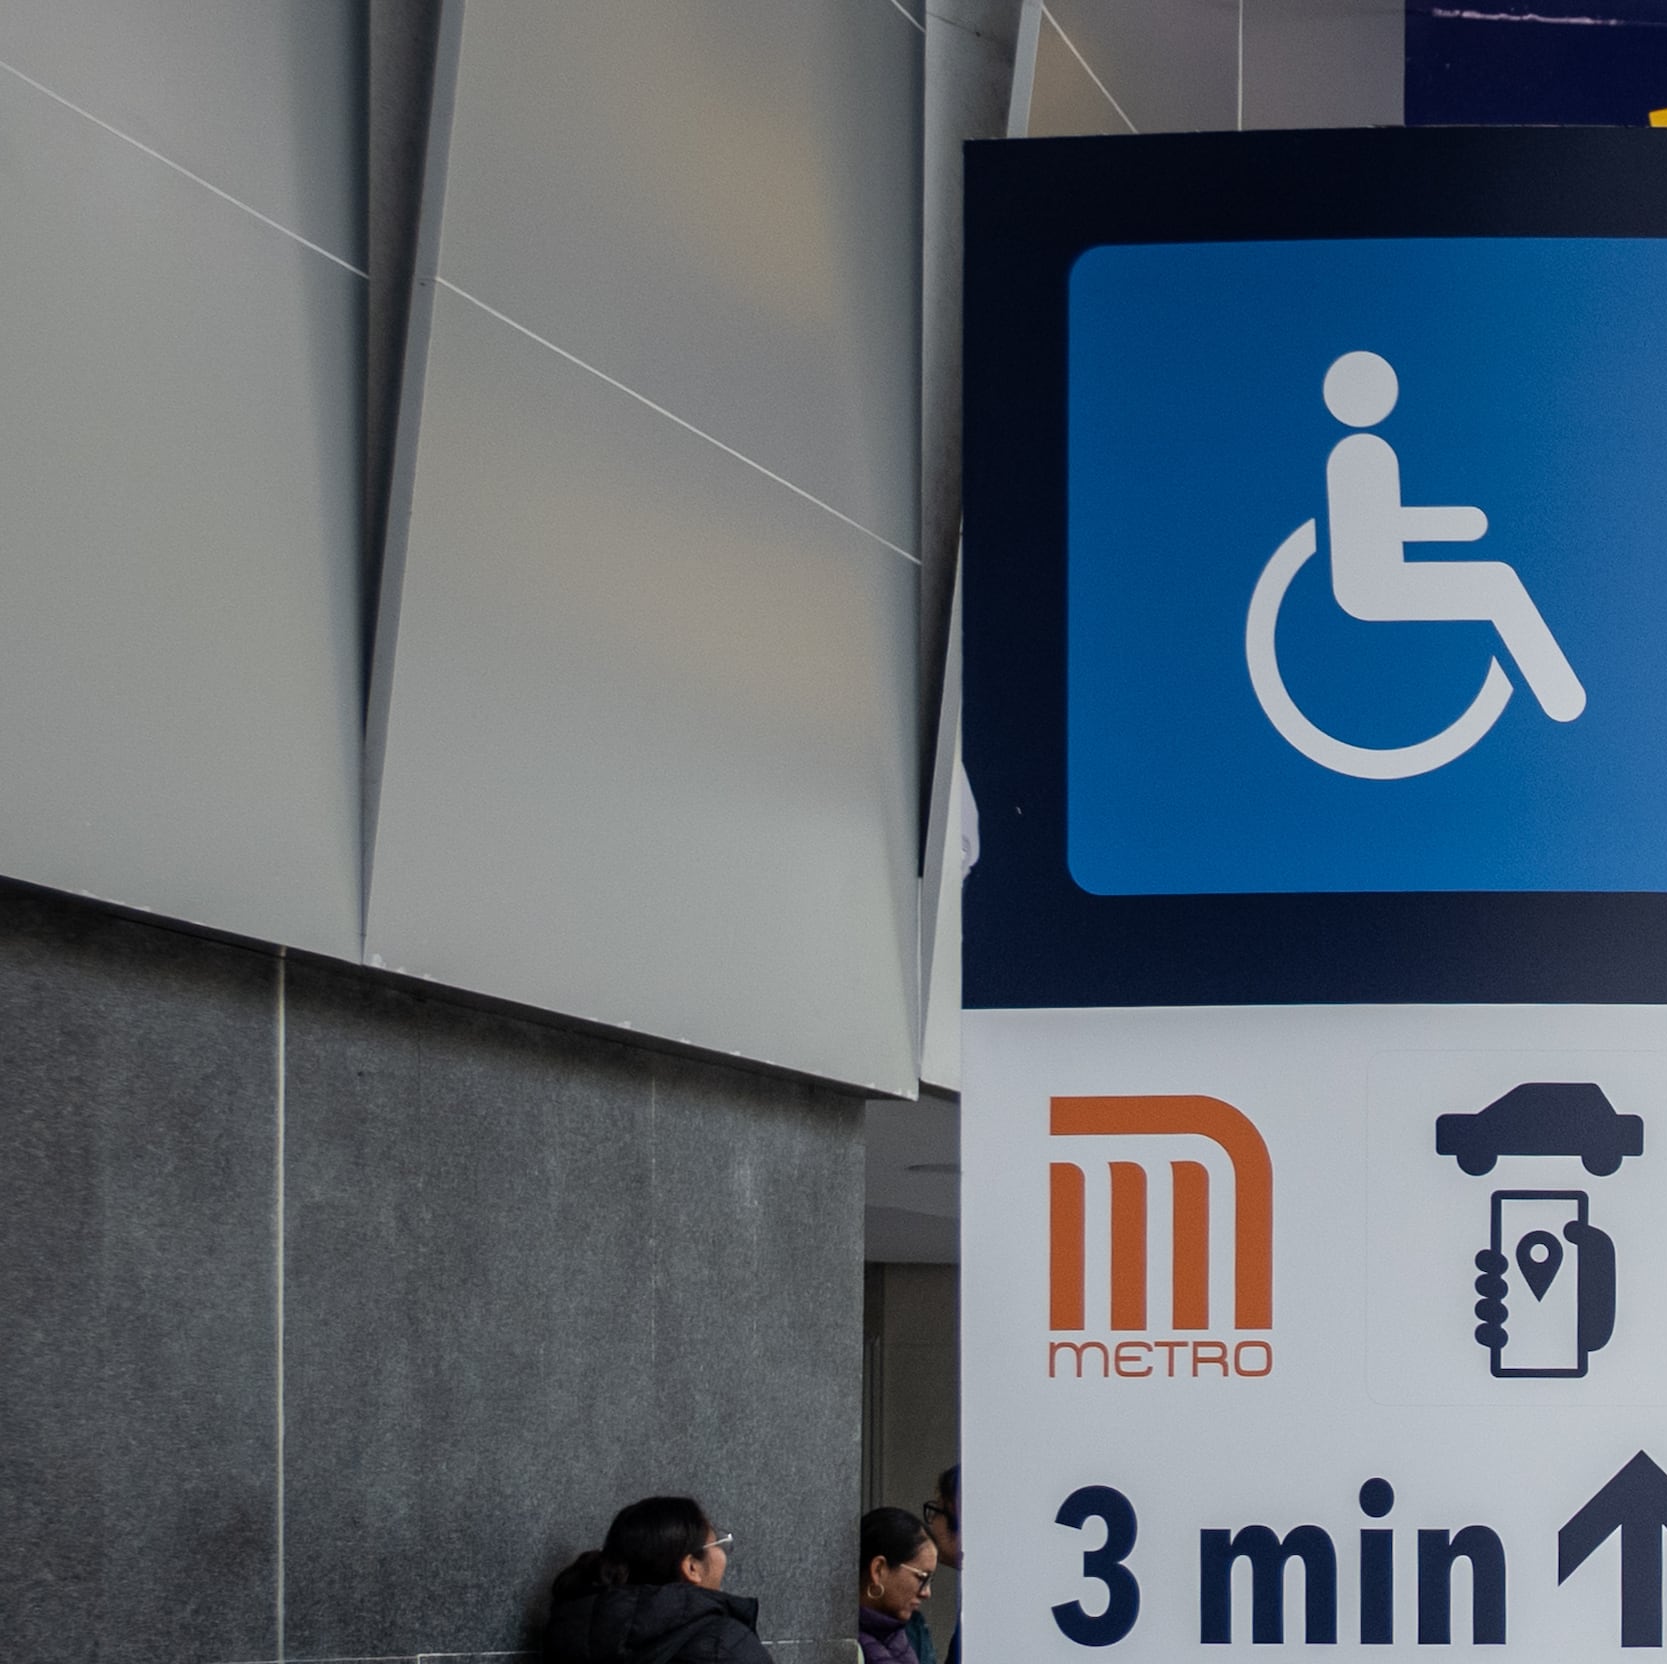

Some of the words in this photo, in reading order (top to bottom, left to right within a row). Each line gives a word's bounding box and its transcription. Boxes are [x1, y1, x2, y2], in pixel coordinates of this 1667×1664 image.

[1049, 1340, 1272, 1378] METRO
[1051, 1485, 1140, 1647] 3
[1200, 1478, 1506, 1644] min
